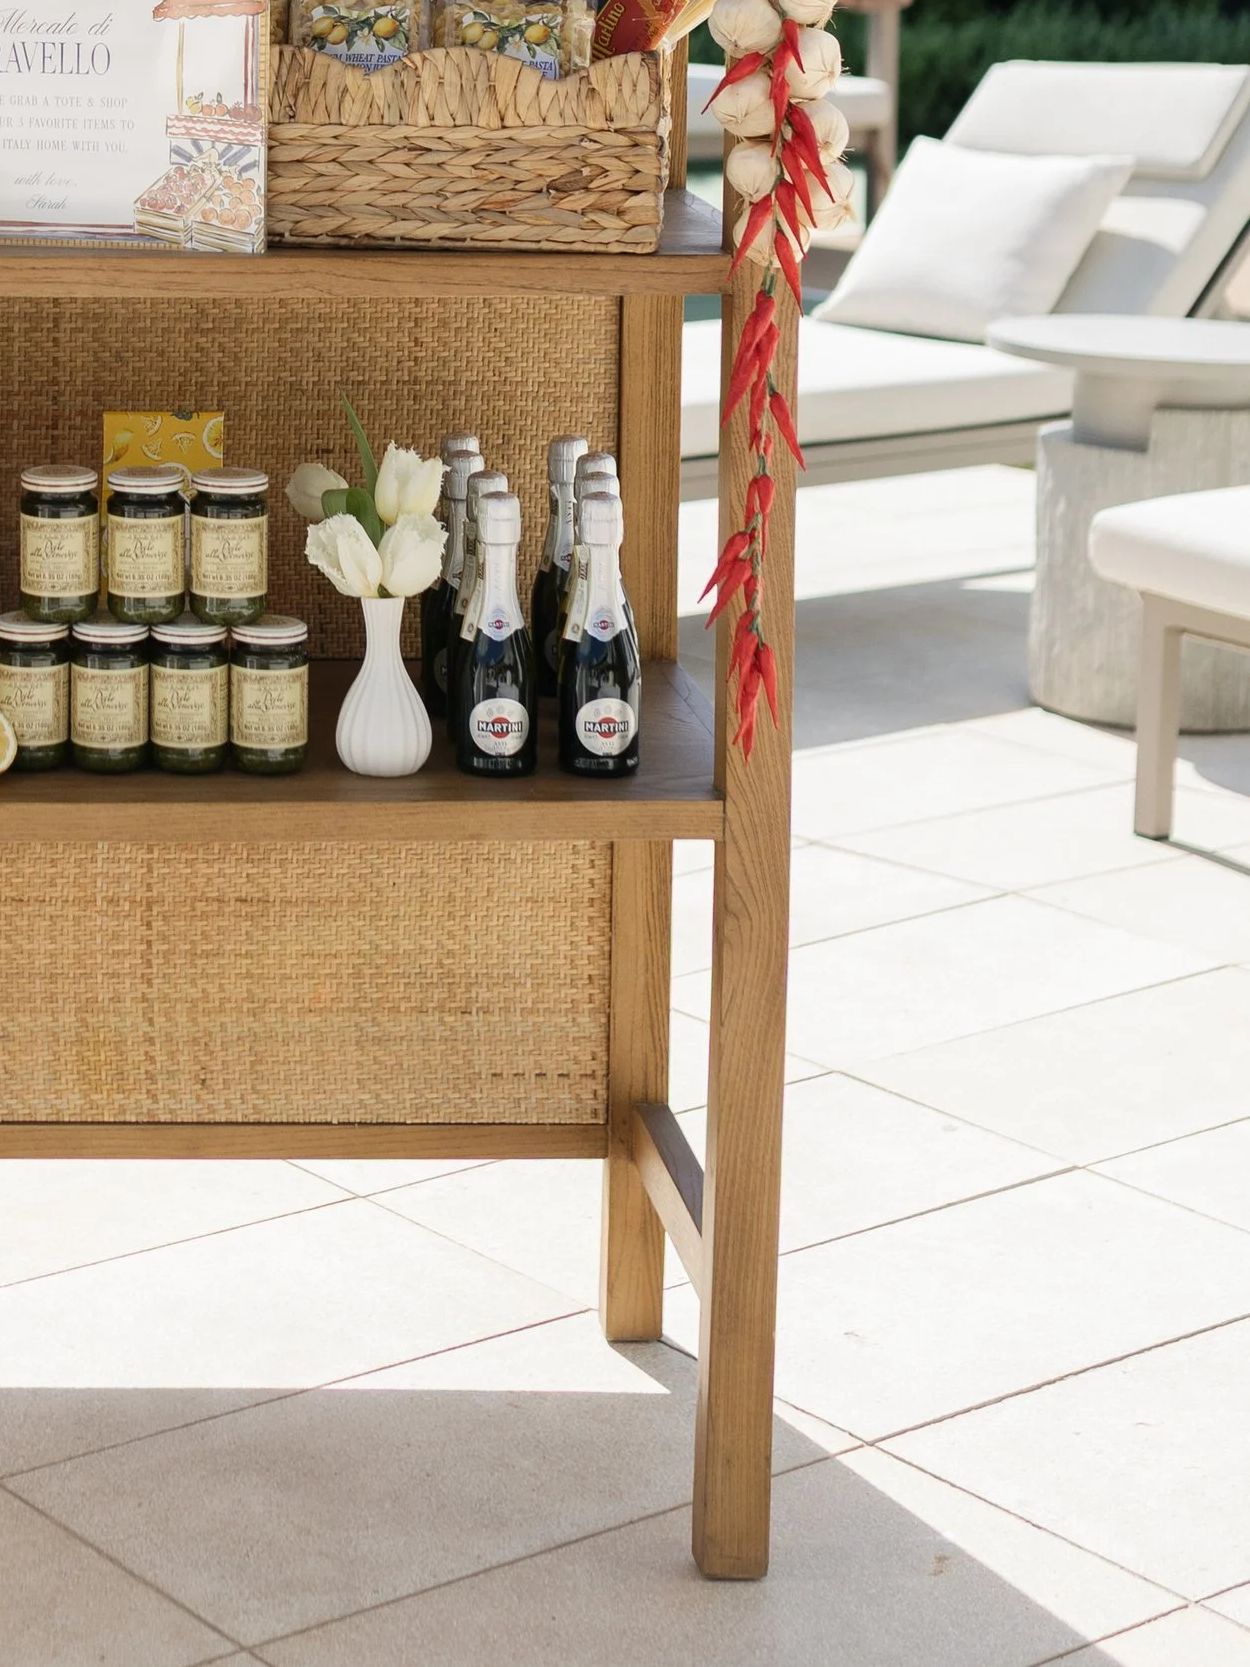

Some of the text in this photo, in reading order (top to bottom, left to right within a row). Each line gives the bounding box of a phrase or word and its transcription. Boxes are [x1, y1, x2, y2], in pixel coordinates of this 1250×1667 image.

[88, 13, 113, 35] di
[345, 53, 375, 63] WHEAT
[529, 61, 554, 71] PASTA
[9, 95, 38, 106] GRAB
[43, 96, 49, 106] A
[54, 96, 82, 107] TOTE
[87, 98, 94, 108] &
[100, 97, 128, 108] SHOP
[29, 117, 78, 129] FAVORITE
[83, 119, 115, 130] ITEMS
[120, 119, 135, 130] TO
[2, 138, 31, 150] ITALY
[36, 139, 67, 151] HOME
[72, 140, 100, 152] WITH
[14, 170, 43, 185] with
[478, 721, 522, 732] MARTINI
[585, 721, 628, 732] MARTINI
